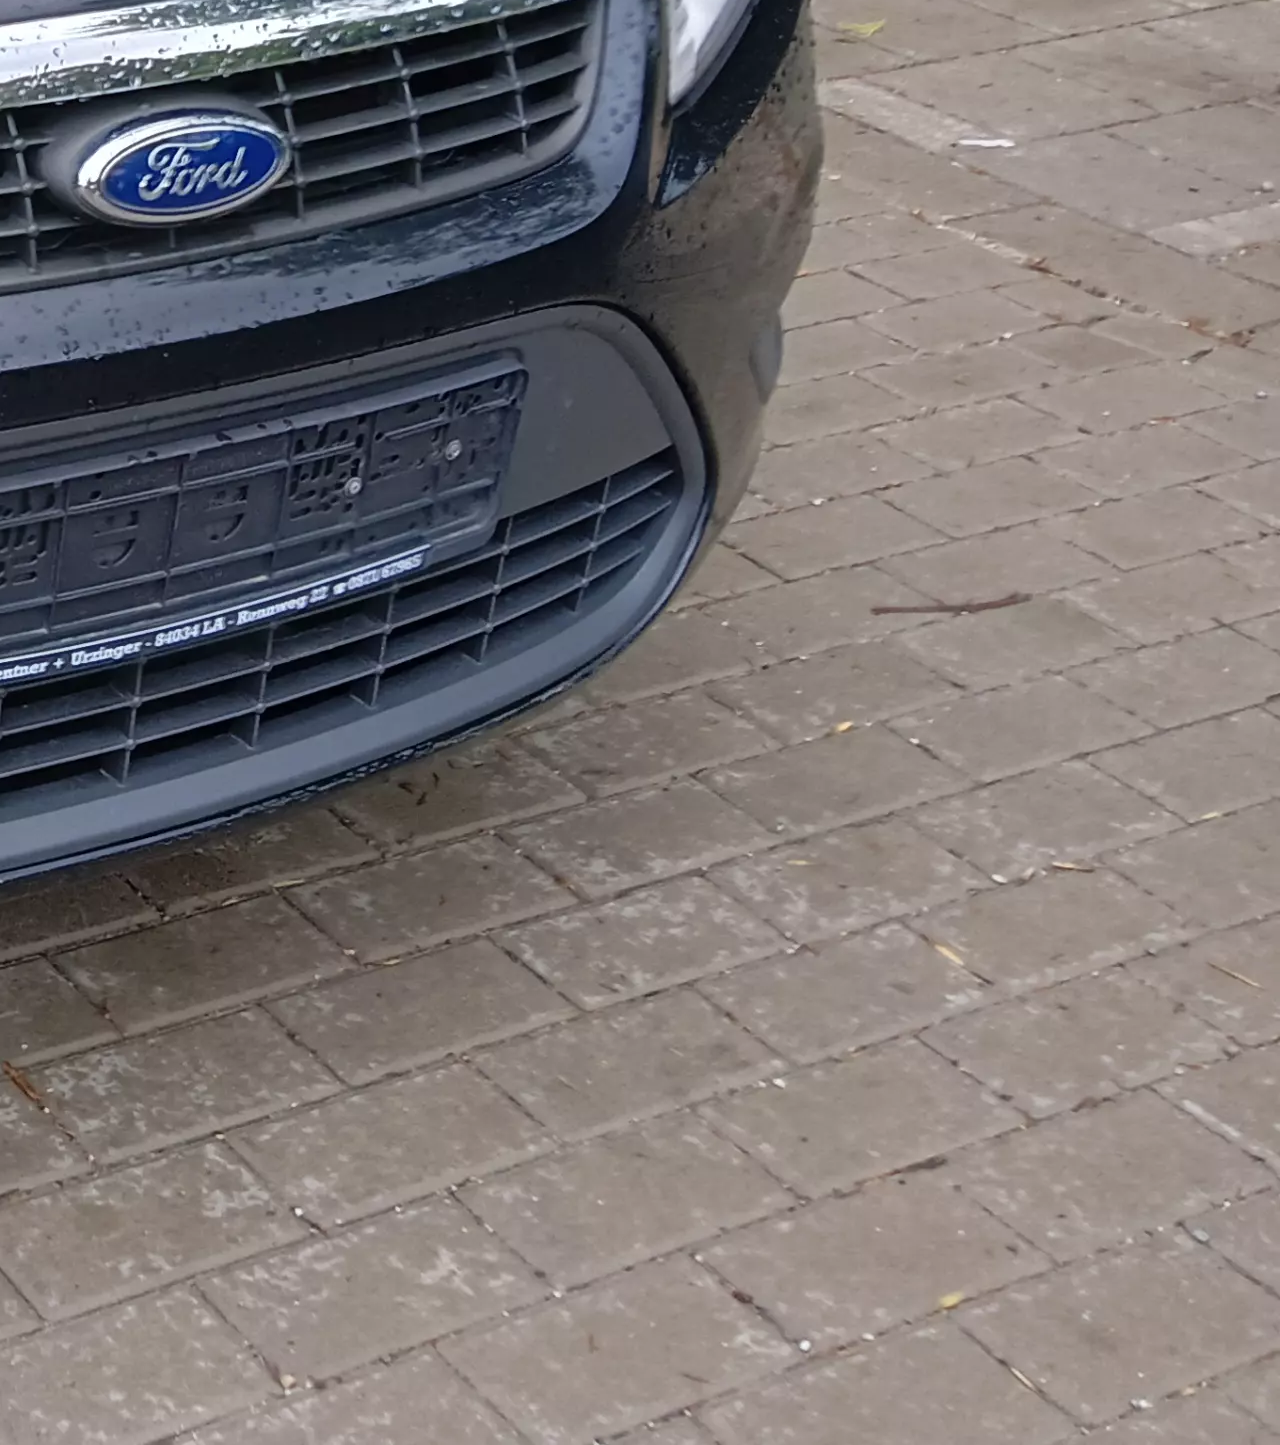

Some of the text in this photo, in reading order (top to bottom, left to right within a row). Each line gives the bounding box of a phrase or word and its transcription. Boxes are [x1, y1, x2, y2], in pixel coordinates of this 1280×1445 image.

[137, 137, 248, 201] Ford
[70, 640, 142, 666] Urzinger
[200, 615, 227, 635] LA
